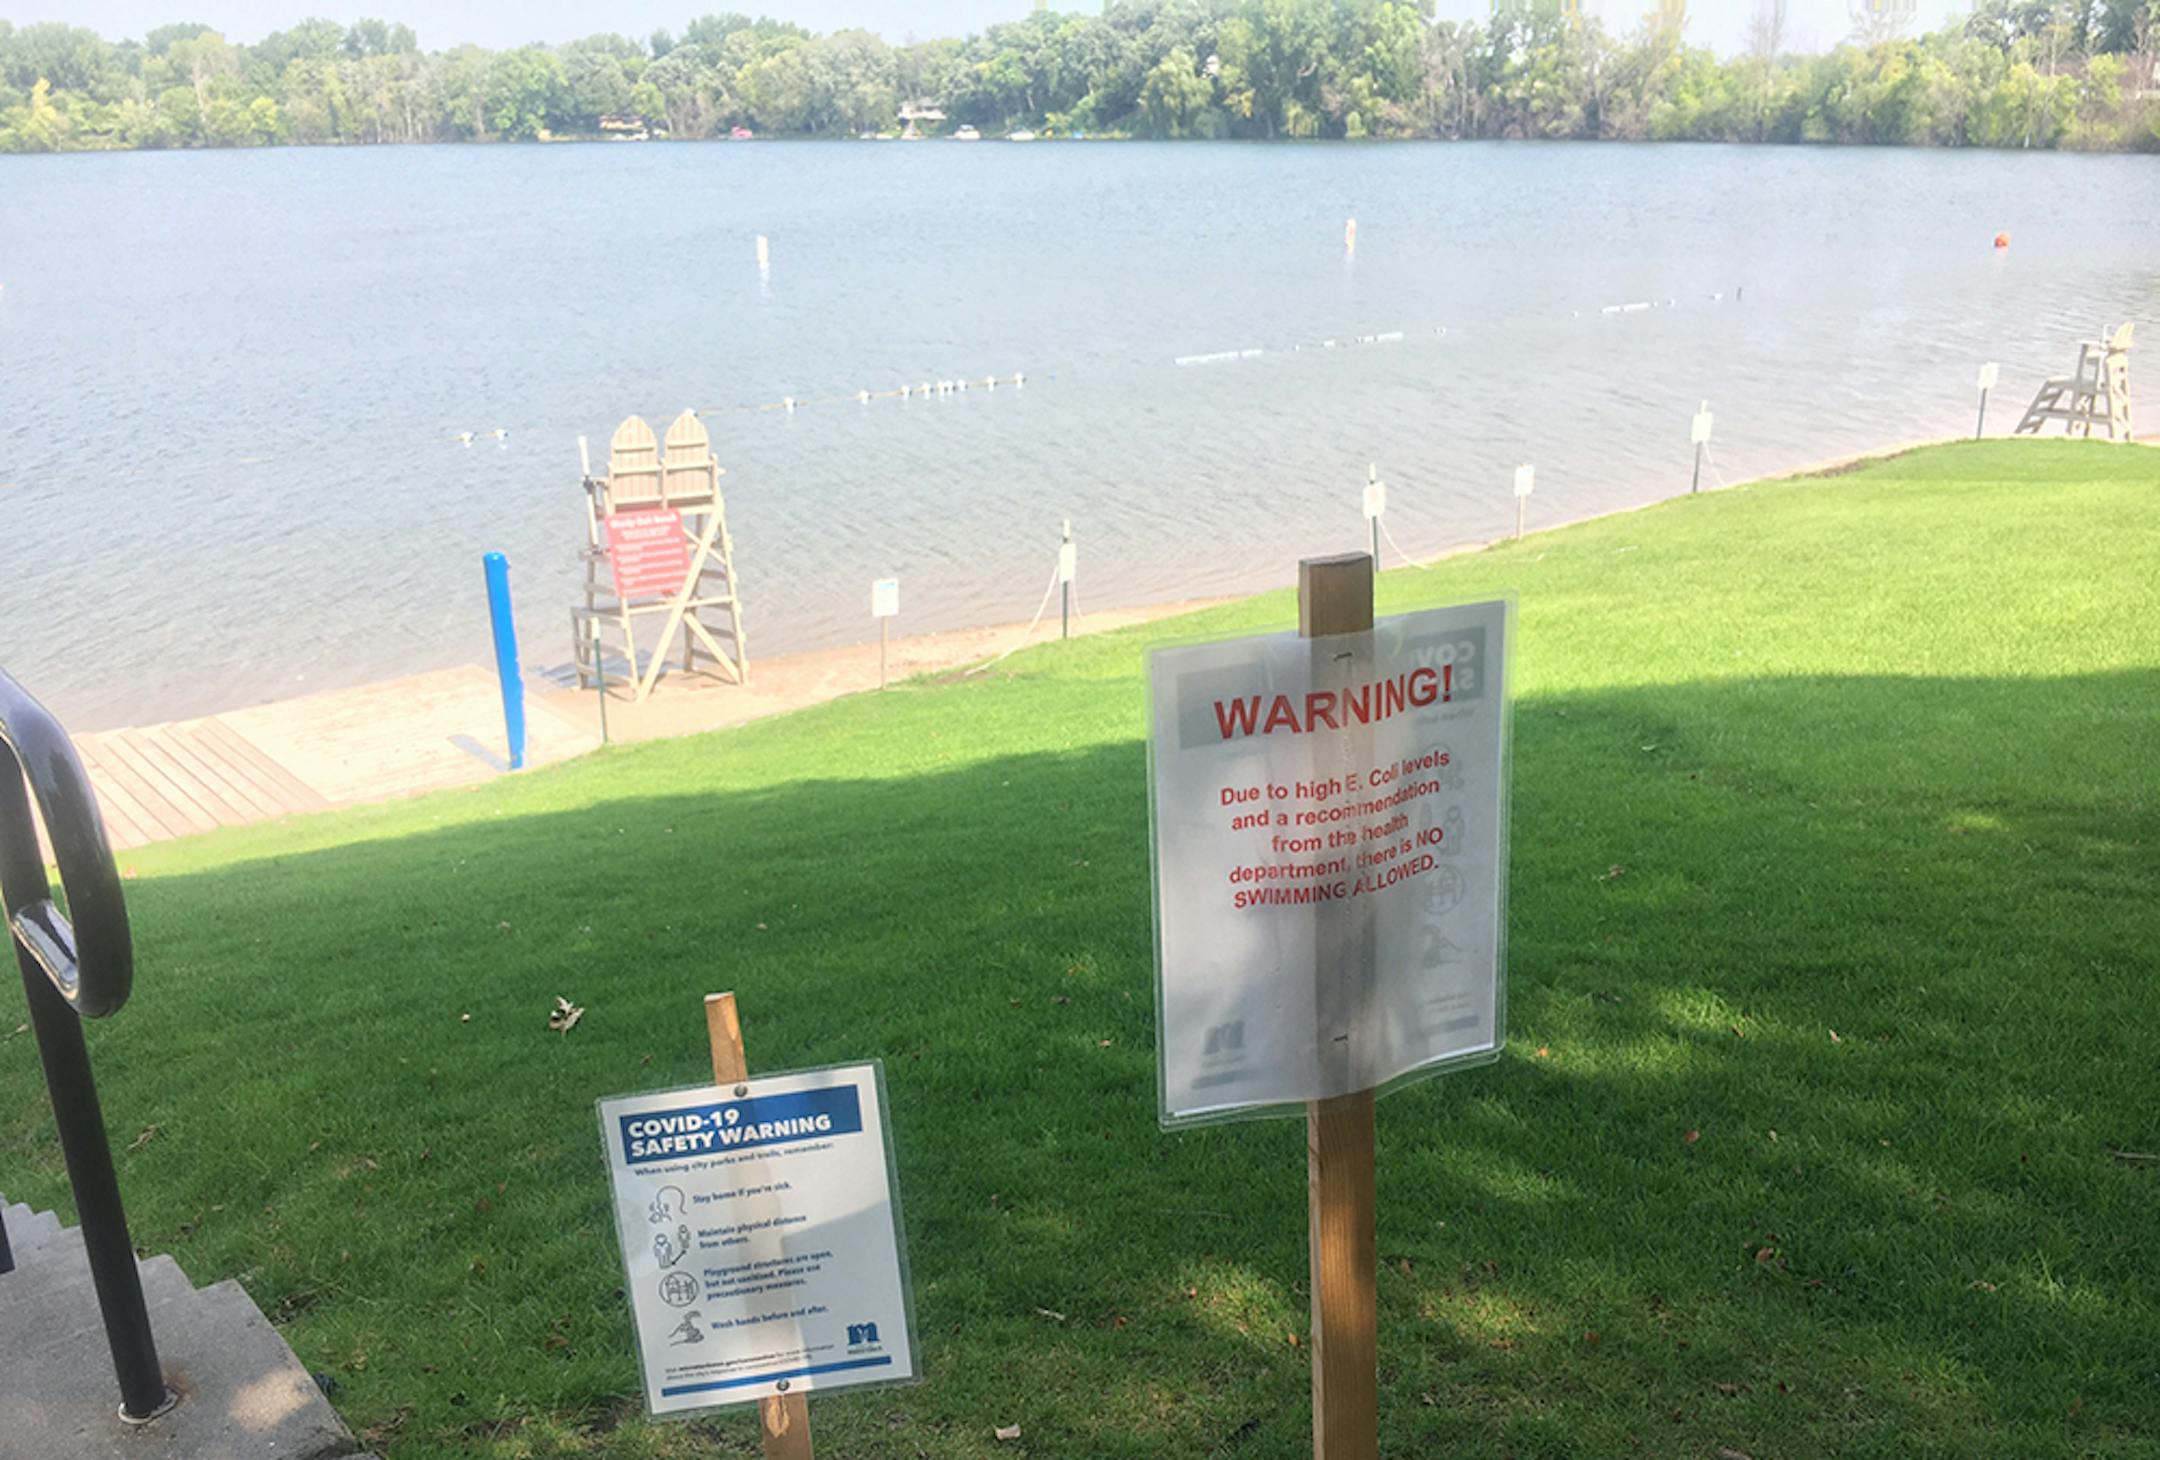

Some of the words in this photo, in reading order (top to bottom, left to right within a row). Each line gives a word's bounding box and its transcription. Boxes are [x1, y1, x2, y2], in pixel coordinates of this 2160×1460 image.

[1213, 664, 1453, 739] WARNING!
[1220, 787, 1260, 806] Due
[1266, 783, 1289, 800] to
[1295, 777, 1342, 801] high
[1345, 773, 1363, 792] E.
[1368, 764, 1398, 788] Coli
[1401, 750, 1451, 775] levels
[1231, 809, 1270, 831] and
[1276, 813, 1289, 826] a
[1295, 779, 1441, 826] recommendation
[1271, 834, 1322, 853] from
[1328, 830, 1358, 849] the
[1362, 812, 1409, 842] health
[1355, 847, 1398, 870] there
[1400, 837, 1413, 855] is
[1415, 826, 1444, 849] NO
[1233, 881, 1348, 910] SWIMMING
[1351, 853, 1440, 898] ALLOWED.
[628, 1109, 740, 1139] COVID-19
[630, 1131, 716, 1158] SAFETY
[718, 1114, 832, 1146] WARNING
[634, 1166, 662, 1177] When
[664, 1163, 690, 1174] using
[691, 1159, 708, 1171] city
[710, 1157, 736, 1169] parks
[738, 1153, 756, 1163] and
[783, 1142, 834, 1156] remember:
[693, 1195, 711, 1204] Stay
[712, 1192, 737, 1200] home
[738, 1188, 745, 1197] if
[697, 1227, 736, 1238] Maintain
[737, 1220, 771, 1235] physical
[773, 1215, 807, 1226] distance
[699, 1241, 719, 1249] from
[703, 1263, 752, 1277] Playground
[753, 1258, 794, 1270] structures
[796, 1255, 809, 1263] are
[704, 1281, 720, 1289] but
[721, 1278, 736, 1287] not
[778, 1267, 805, 1277] Please
[806, 1265, 821, 1273] use
[706, 1286, 764, 1302] precautionary
[711, 1320, 734, 1330] Wash
[735, 1316, 761, 1326] hands
[762, 1312, 789, 1323] before
[790, 1307, 806, 1318] and
